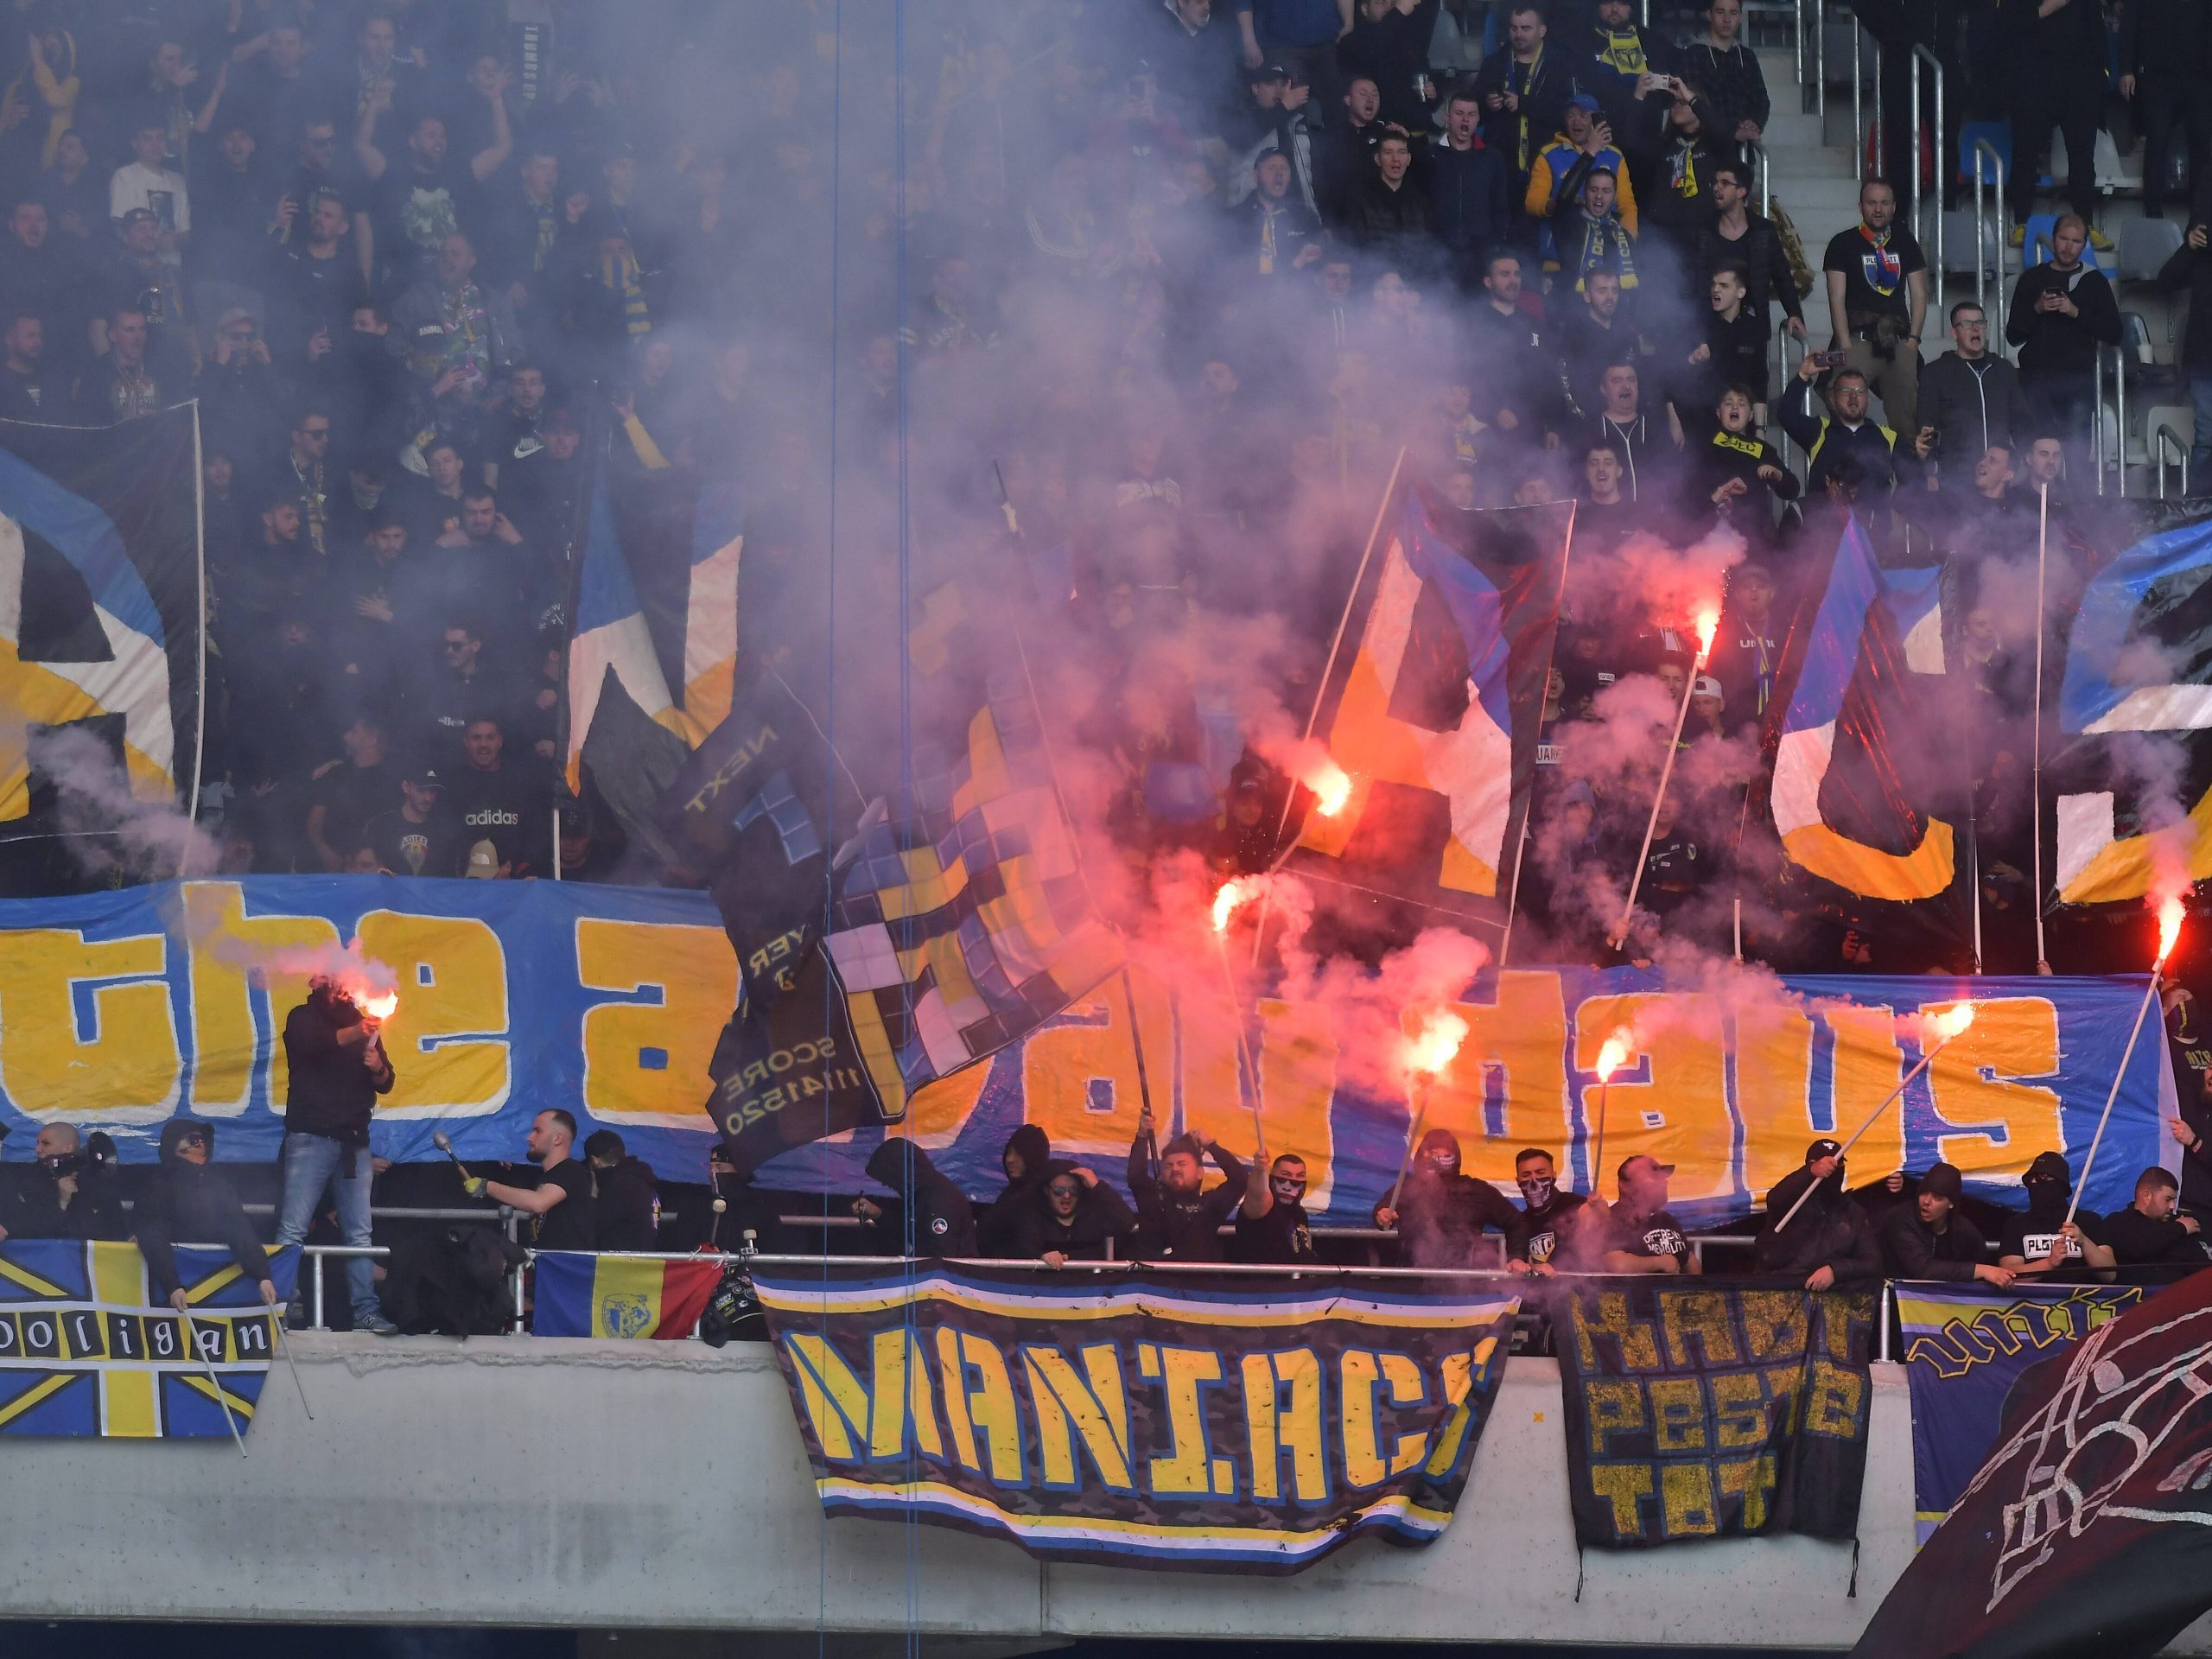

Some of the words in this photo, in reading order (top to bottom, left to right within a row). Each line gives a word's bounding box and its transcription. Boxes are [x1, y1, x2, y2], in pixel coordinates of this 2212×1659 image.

[466, 810, 518, 826] adidas
[0, 880, 512, 1121] the
[785, 1326, 1500, 1505] MANIACS
[1591, 1456, 1776, 1535] TOT
